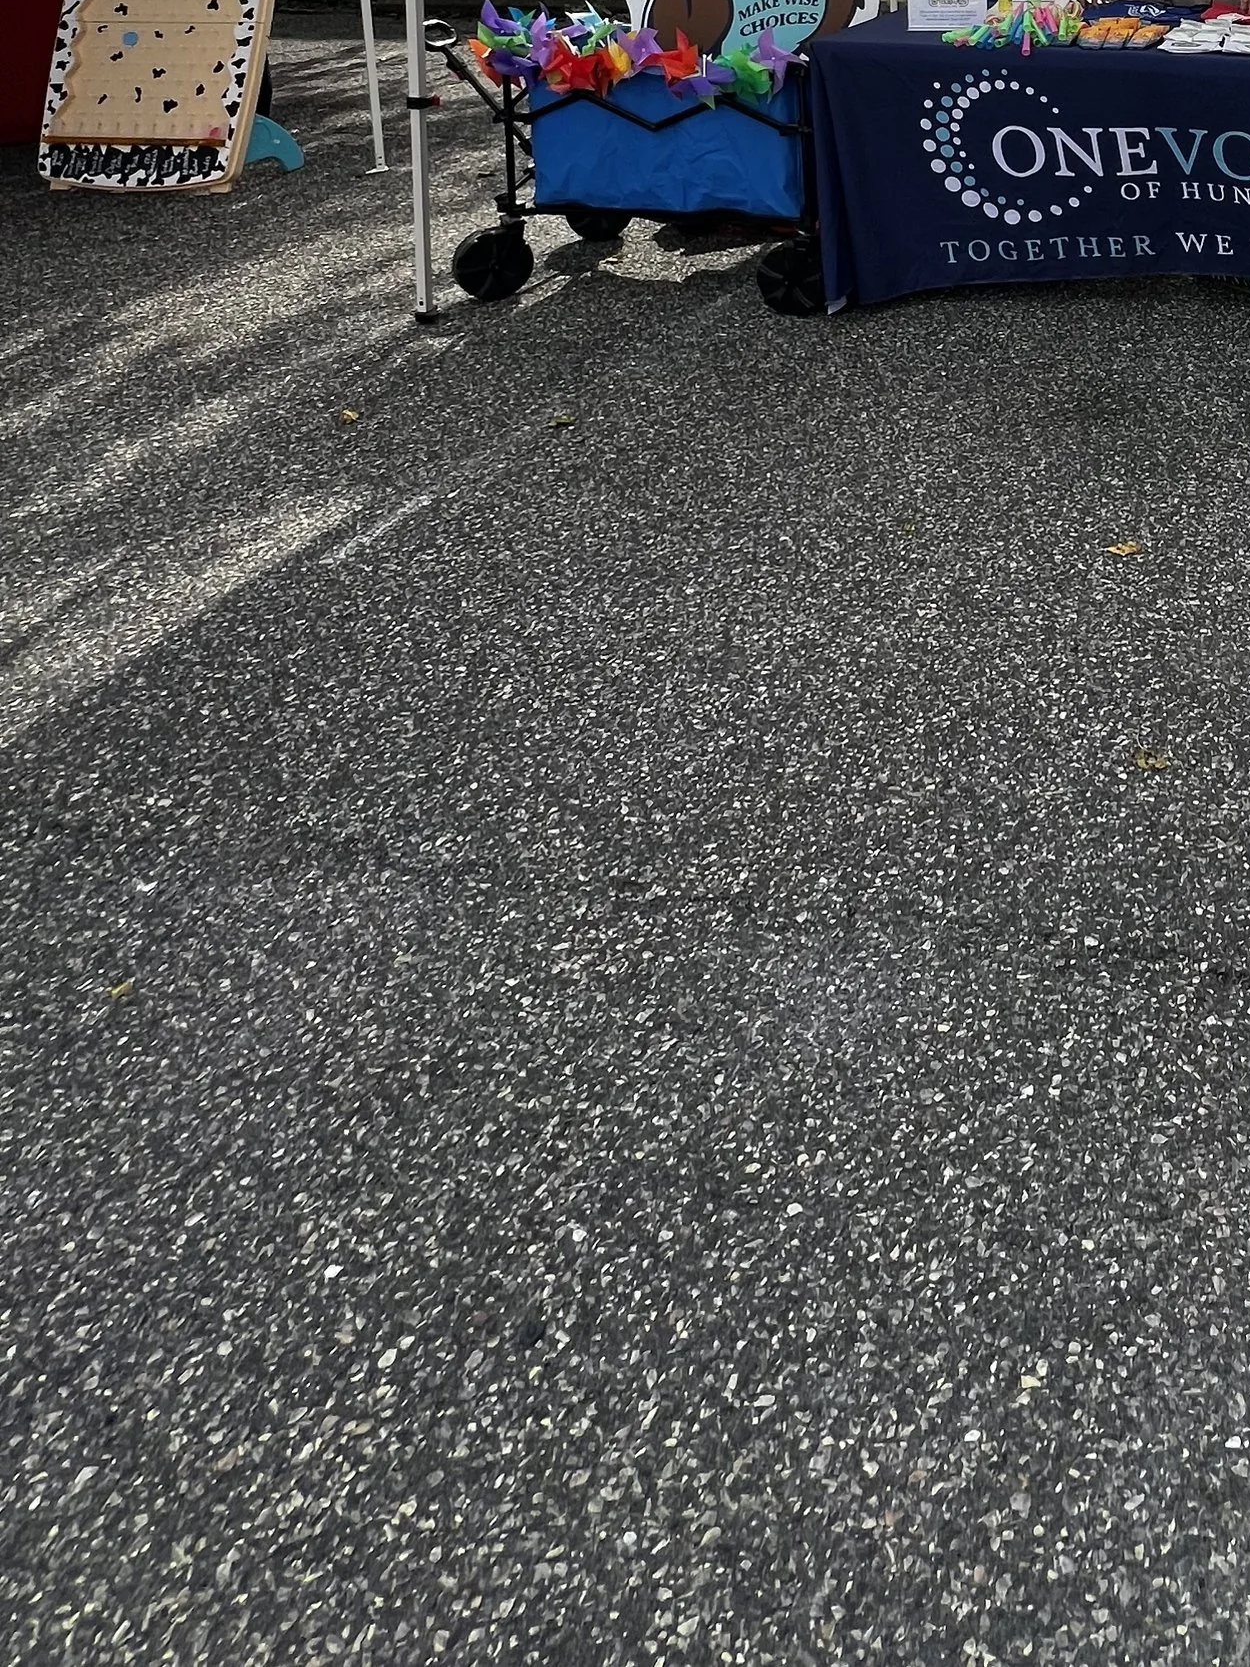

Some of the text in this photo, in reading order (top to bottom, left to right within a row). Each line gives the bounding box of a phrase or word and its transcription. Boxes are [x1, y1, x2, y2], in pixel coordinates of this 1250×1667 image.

[739, 11, 819, 37] CHOICES
[1120, 181, 1161, 201] OF
[938, 235, 1157, 264] TOGETHER
[1175, 232, 1235, 257] WE
